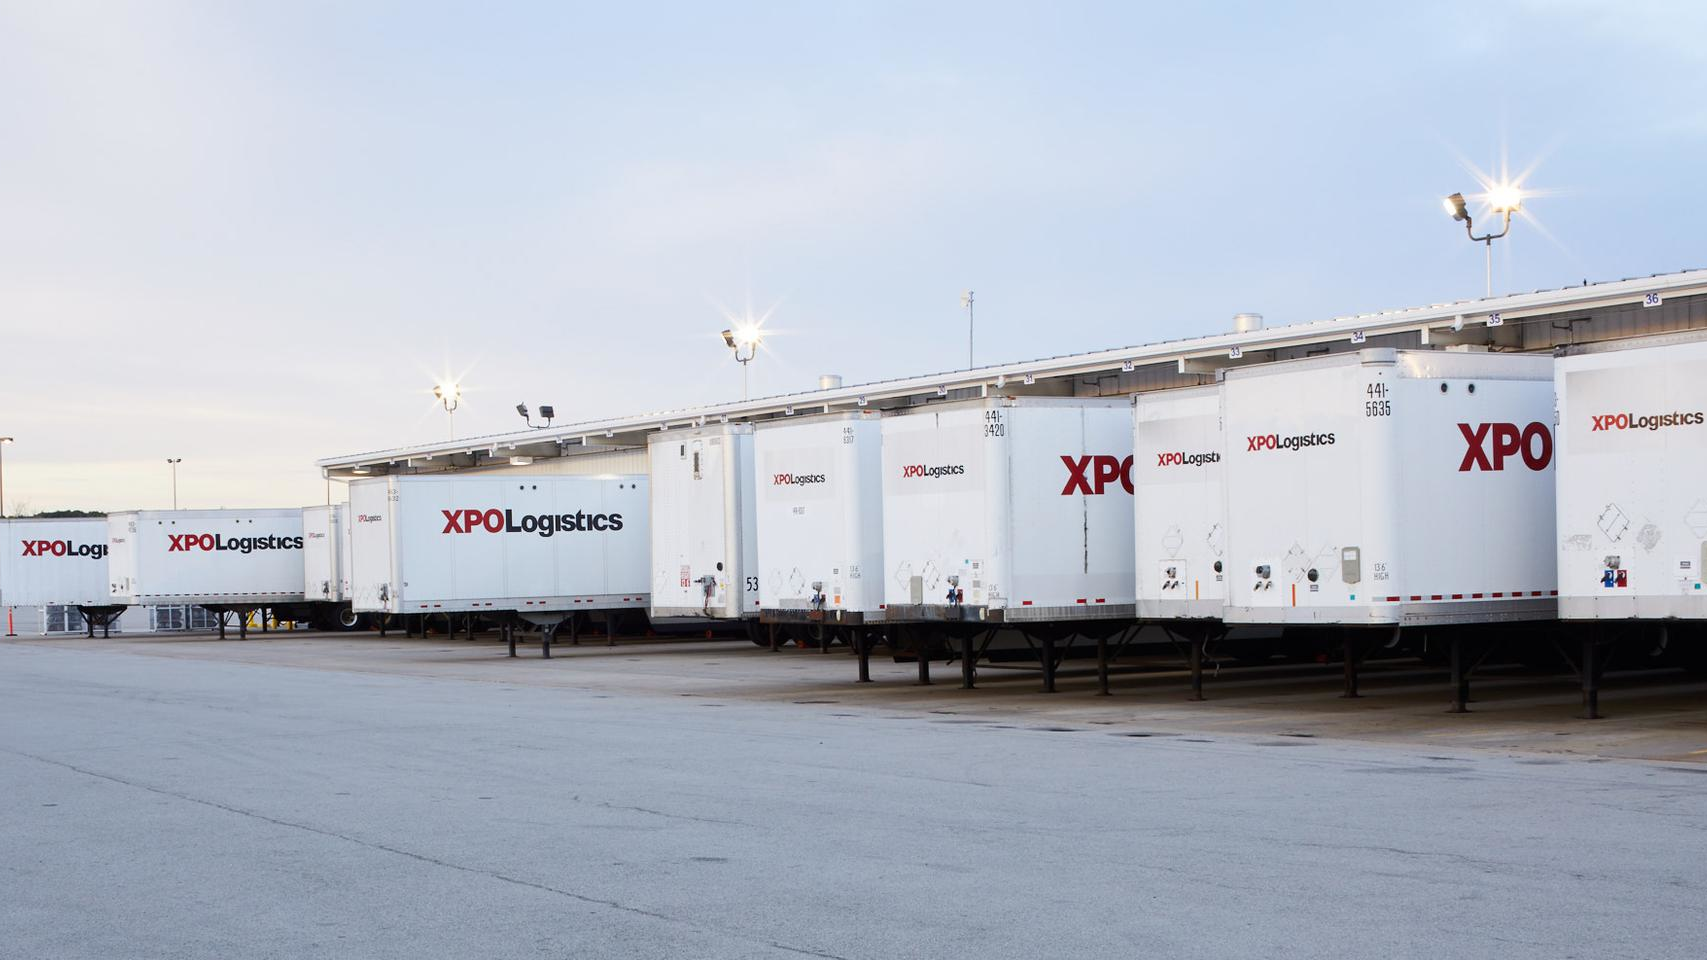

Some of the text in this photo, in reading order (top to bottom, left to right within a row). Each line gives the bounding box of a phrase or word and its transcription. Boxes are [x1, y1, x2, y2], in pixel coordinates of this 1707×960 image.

[1646, 293, 1659, 304] 36
[1489, 313, 1501, 324] 35
[1352, 331, 1364, 341] 34
[1230, 346, 1240, 356] 33
[1123, 360, 1133, 370] 32
[1025, 373, 1034, 383] 31
[1365, 400, 1391, 417] 5635
[1590, 411, 1703, 432] XPOLogistics
[983, 423, 1004, 438] 3420
[1246, 432, 1336, 452] XPOLogistics
[1457, 421, 1555, 472] XPO
[1157, 450, 1221, 467] XPOLogisti
[902, 464, 964, 478] XPOLogistics
[772, 473, 826, 487] XPOLogistics
[441, 508, 623, 538] XPOLogistics
[21, 540, 109, 560] XPOLogi
[167, 532, 304, 555] XPOLogistics
[745, 576, 759, 592] 53
